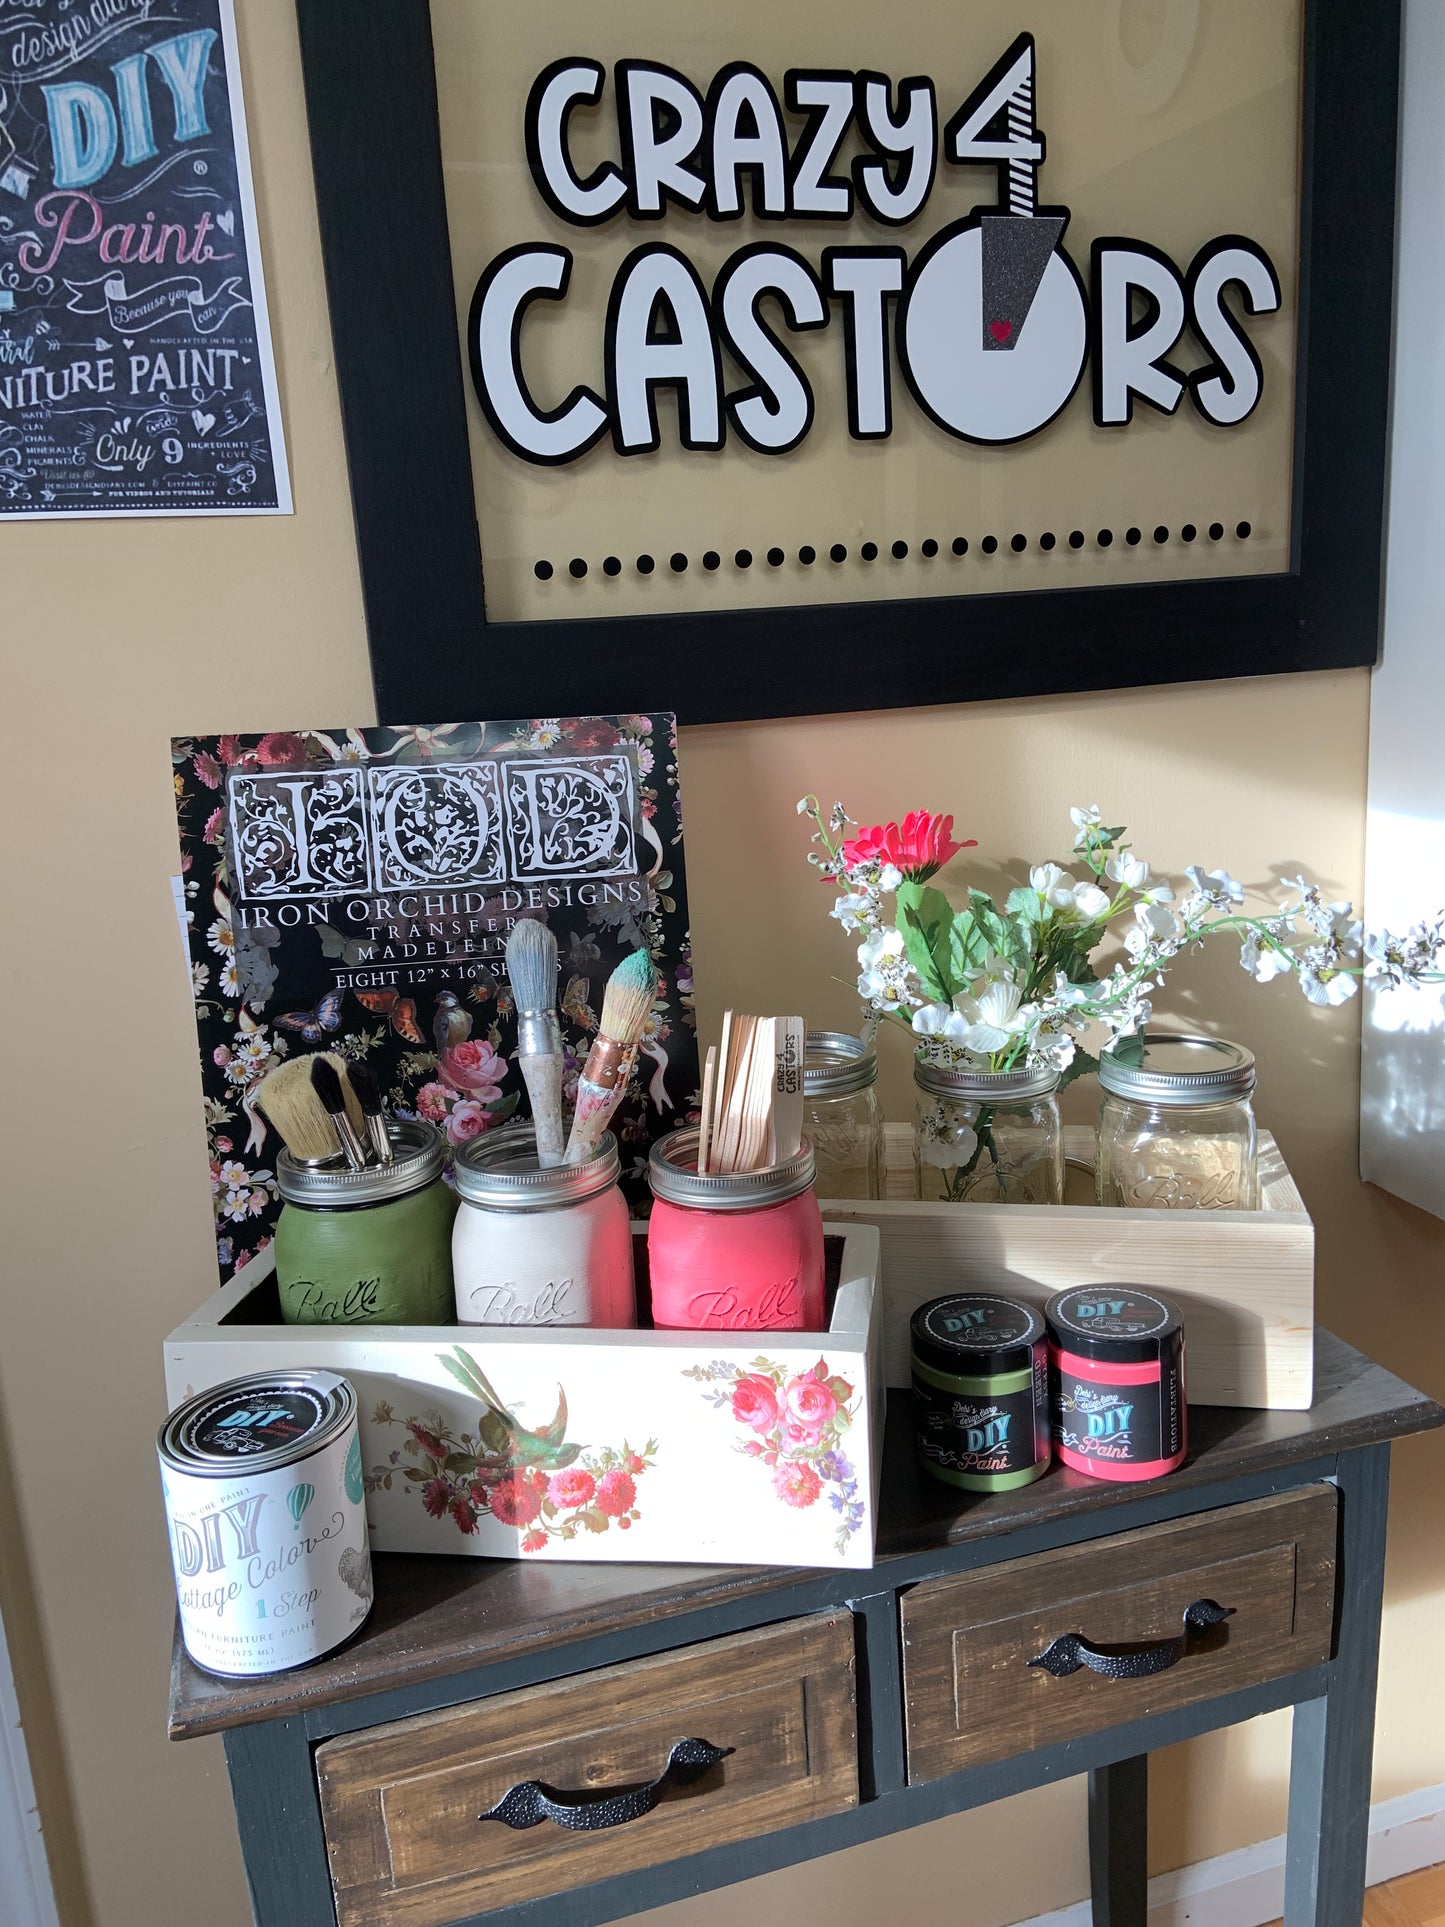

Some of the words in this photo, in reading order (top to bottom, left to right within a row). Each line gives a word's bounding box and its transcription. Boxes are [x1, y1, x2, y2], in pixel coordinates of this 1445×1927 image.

[12, 14, 91, 67] design
[40, 28, 219, 189] DIY
[525, 57, 937, 227] CRAZY
[945, 31, 1046, 212] 4
[18, 190, 236, 274] Paint
[113, 293, 167, 324] Because
[168, 289, 189, 307] you
[197, 305, 217, 324] can
[469, 230, 1282, 466] CASTORS
[129, 349, 240, 395] PAINT
[21, 410, 52, 419] WATER
[22, 423, 44, 431] CLAY
[24, 434, 55, 443] CHALK
[26, 445, 73, 455] MINERALS
[96, 433, 156, 472] Only
[162, 437, 184, 464] 9
[187, 441, 250, 449] INGREDIENTS
[221, 450, 248, 459] LOVE
[240, 902, 330, 930] IRON
[346, 891, 486, 921] ORCHID
[500, 880, 642, 911] DESIGNS
[366, 917, 517, 941] TRANSFER
[335, 970, 400, 989] EIGHT
[943, 1308, 987, 1333] DIY
[1076, 1300, 1127, 1317] DIY
[216, 1410, 292, 1427] DIY
[1087, 1404, 1134, 1437] DIY
[966, 1413, 1012, 1452] DIY
[1078, 1435, 1135, 1458] Paint
[957, 1451, 1013, 1470] Paint
[219, 1487, 251, 1504] PAINT
[173, 1493, 269, 1577] DIY
[255, 1598, 268, 1619] 1
[273, 1588, 322, 1617] Step
[210, 1632, 276, 1645] FURNITURE
[281, 1619, 316, 1639] PAINT
